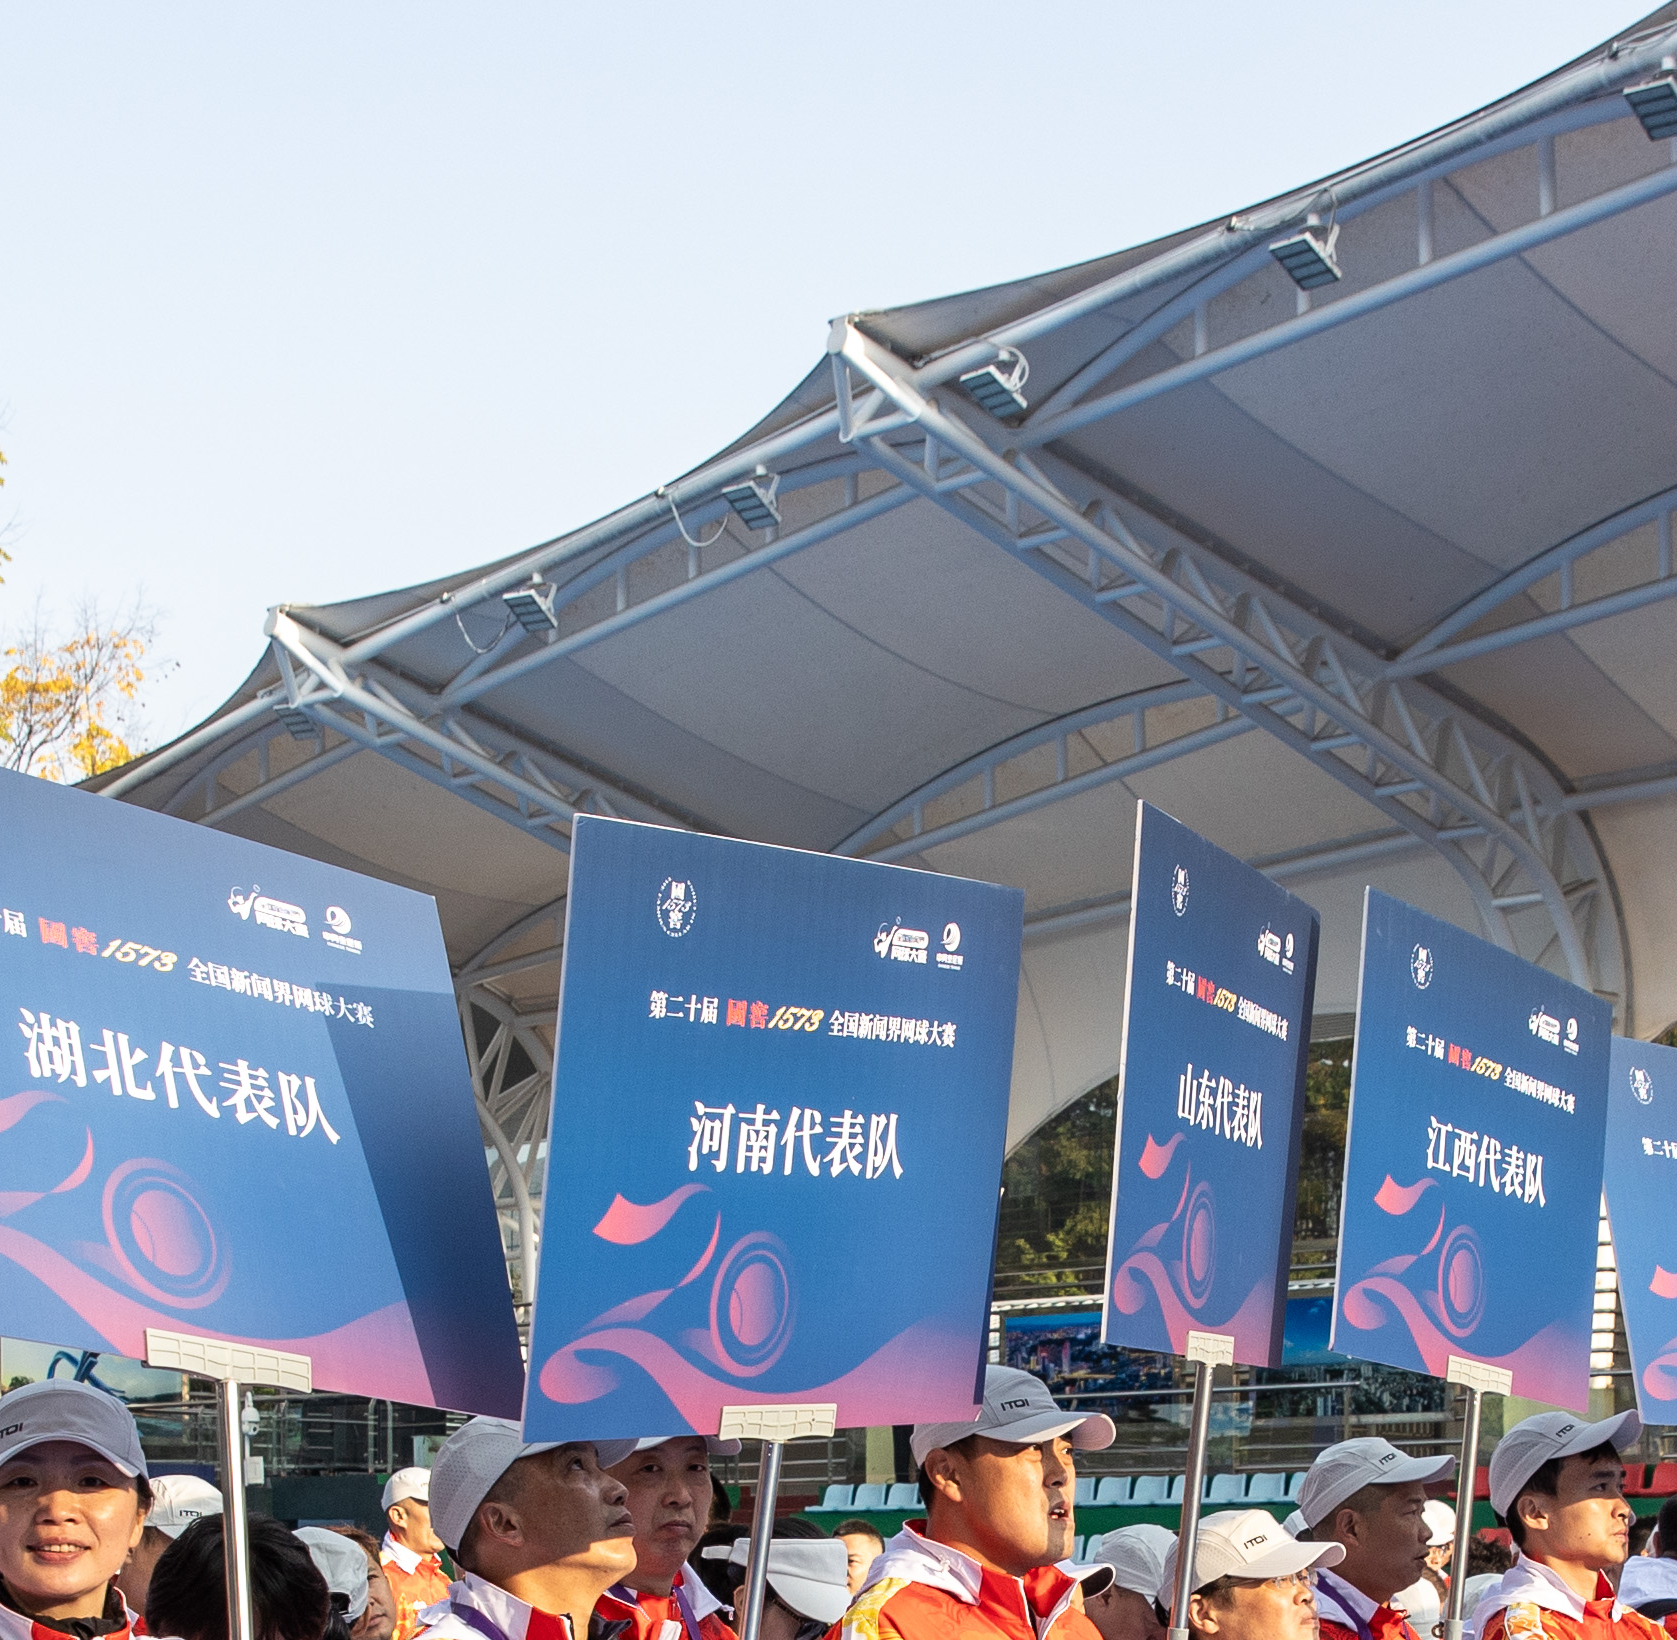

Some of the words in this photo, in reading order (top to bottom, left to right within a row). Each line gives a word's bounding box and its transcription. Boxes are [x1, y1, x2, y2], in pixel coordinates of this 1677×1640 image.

[187, 957, 374, 1028] 全国新闻界网球大赛
[649, 990, 718, 1024] 第二十届
[828, 1010, 957, 1048] 全国新闻界网球大赛
[18, 1007, 341, 1145] 湖北代表队
[1406, 1025, 1445, 1060] 第二十届
[687, 1099, 903, 1179] 河南代表队
[1177, 1063, 1262, 1150] 山东代表队
[1426, 1115, 1546, 1207] 江西代表队
